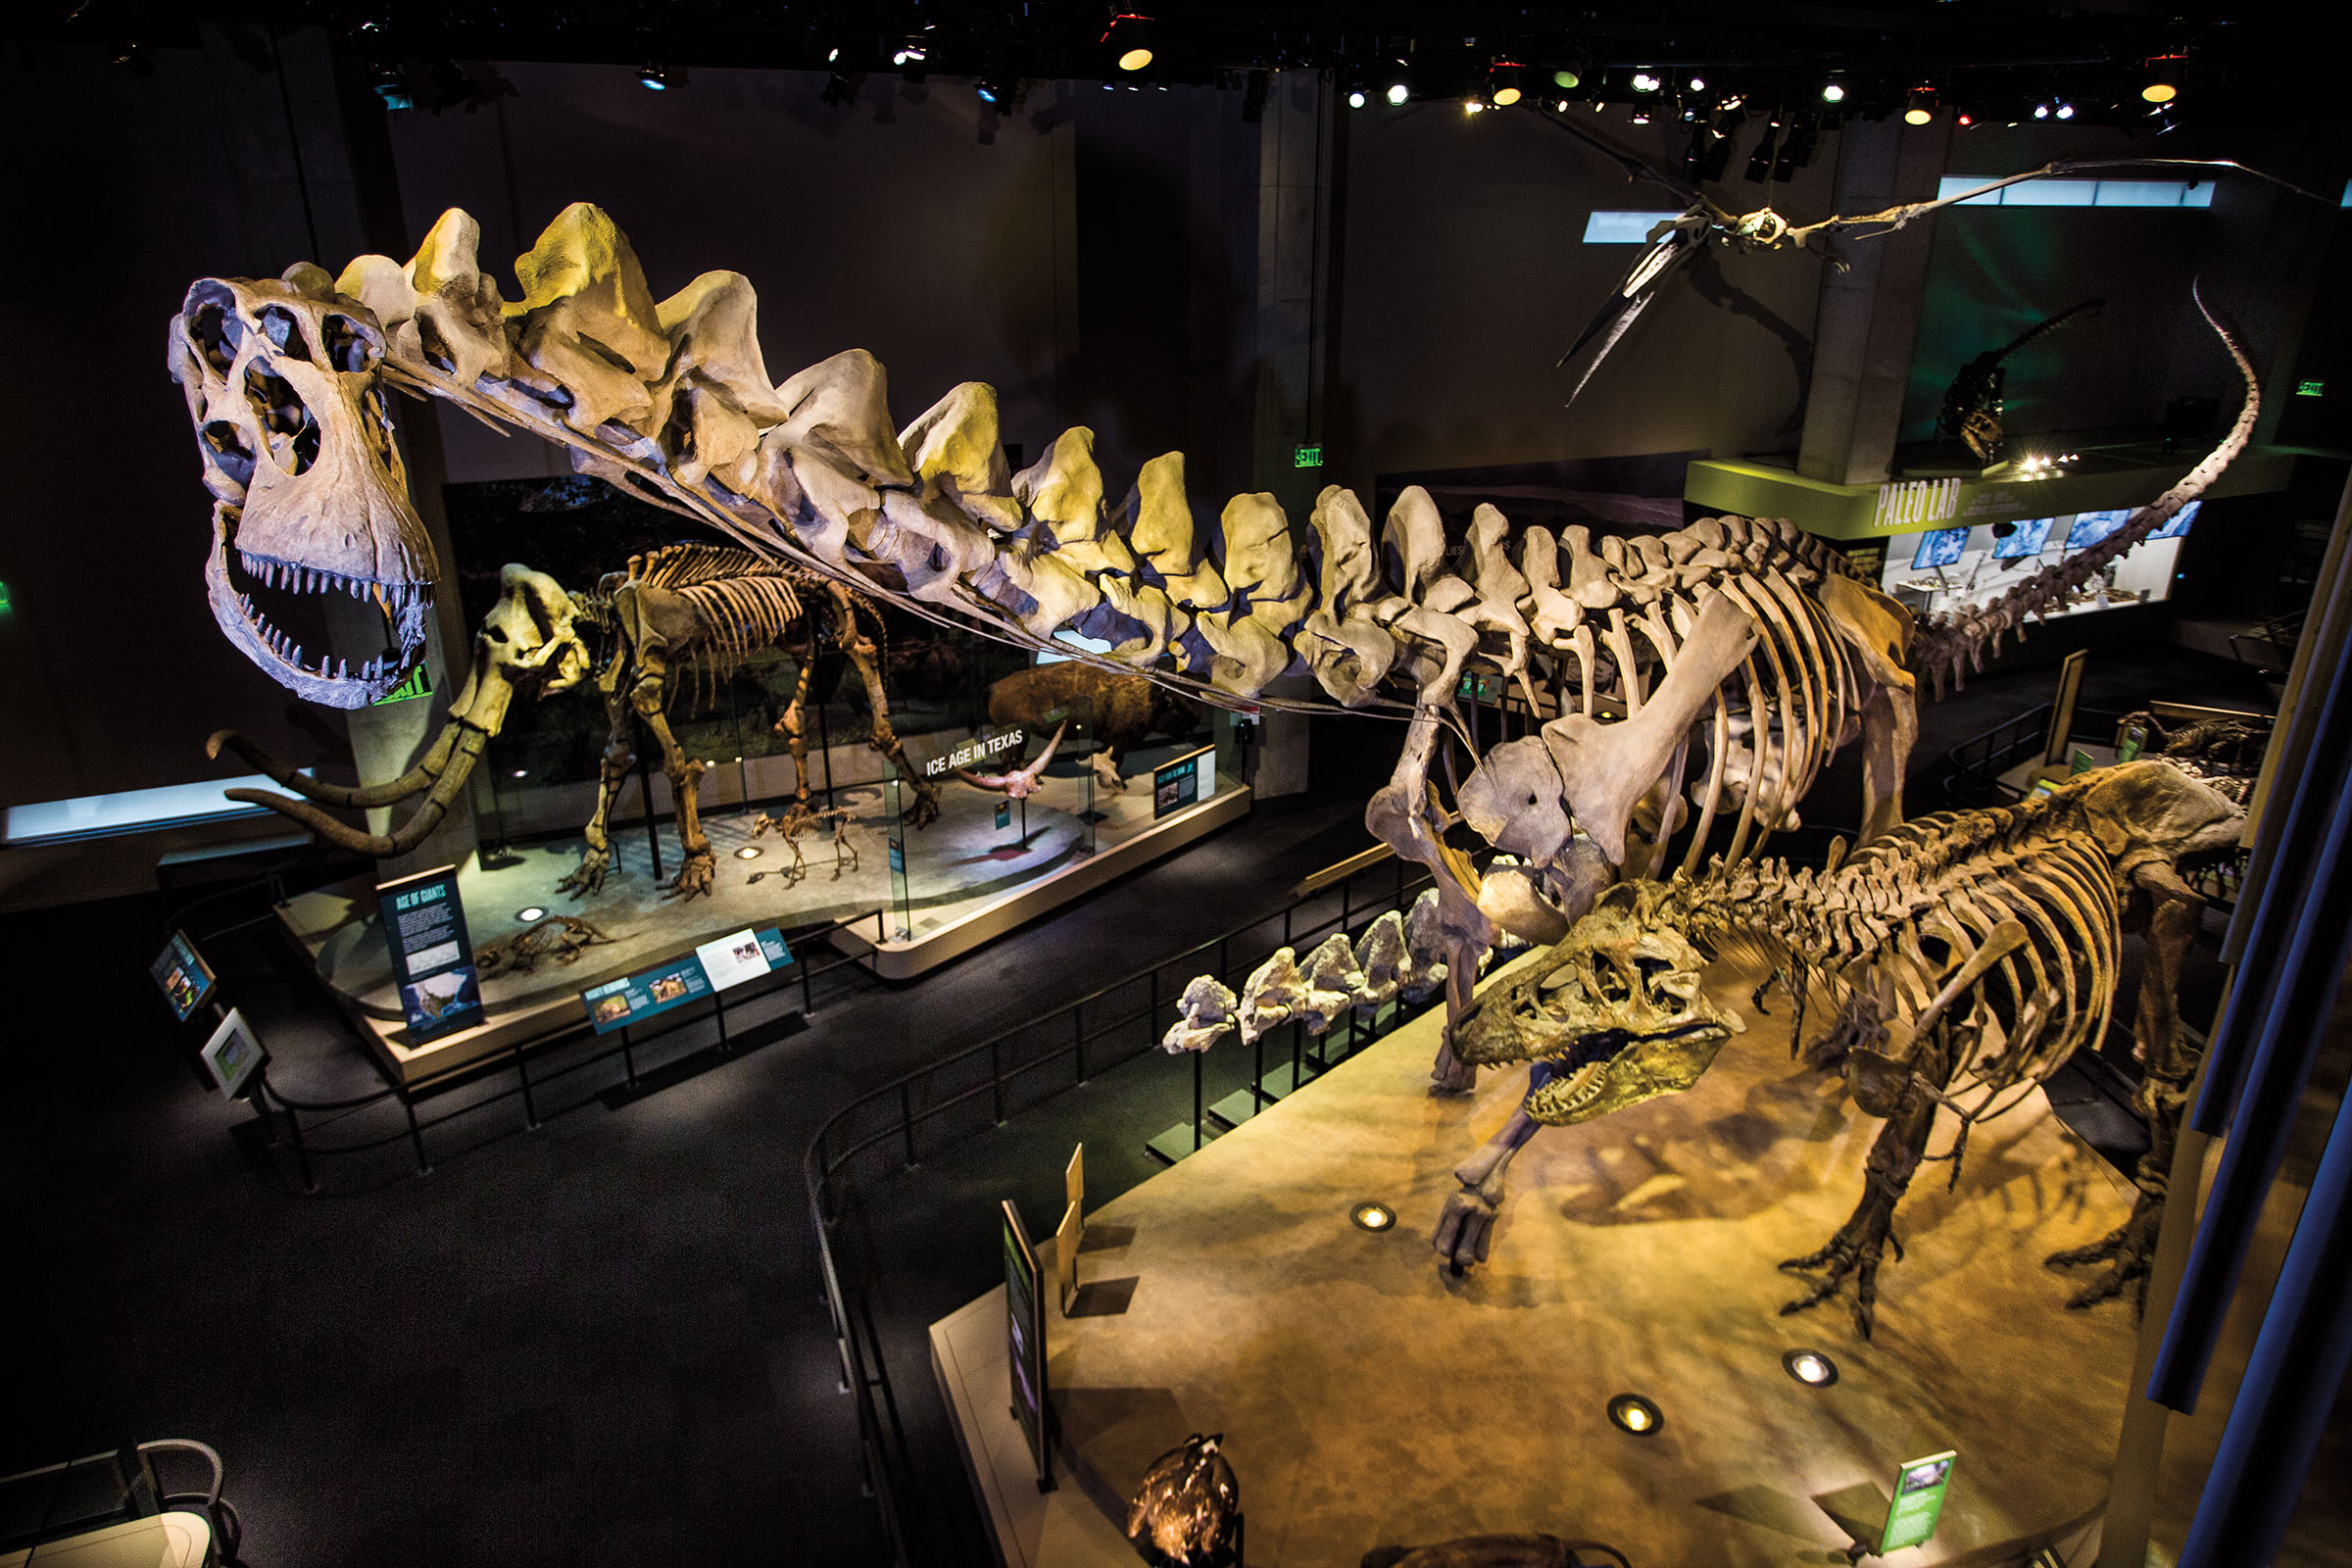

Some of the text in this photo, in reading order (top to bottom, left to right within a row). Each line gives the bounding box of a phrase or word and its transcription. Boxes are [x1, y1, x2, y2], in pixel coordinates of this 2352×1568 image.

[1299, 448, 1320, 465] EXIT
[1874, 477, 1961, 527] PALEO LAB
[926, 729, 1023, 776] ICE AGE IN TEXAS
[410, 891, 419, 906] OF
